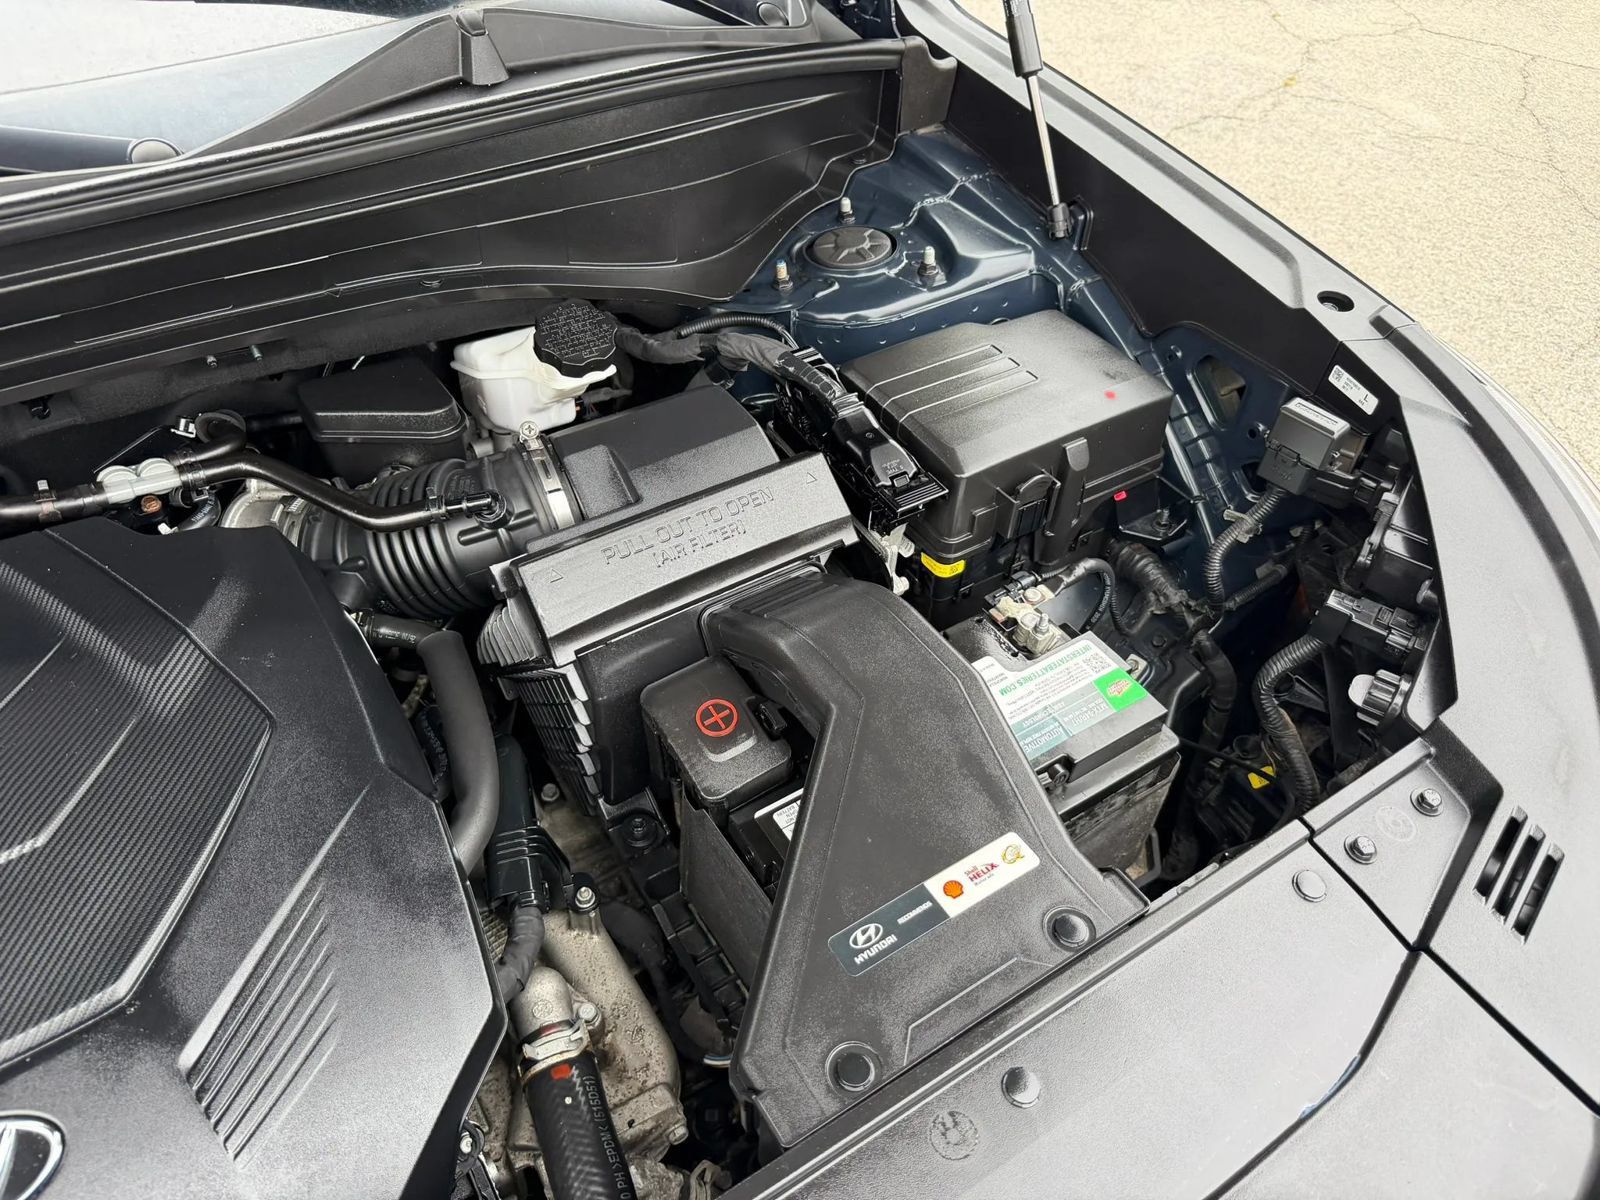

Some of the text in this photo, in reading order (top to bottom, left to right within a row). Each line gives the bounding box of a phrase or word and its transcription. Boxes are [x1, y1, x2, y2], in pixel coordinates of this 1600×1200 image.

[601, 486, 775, 565] PULL OUT TO OPEN
[652, 519, 747, 568] (AIR FILTER)
[999, 644, 1092, 696] INTERSTATEBATTERIES.COM
[1023, 727, 1063, 753] AUTOMOTIVE
[968, 862, 999, 882] HELIX
[854, 933, 898, 965] HYUNDAI
[613, 1171, 627, 1189] PH
